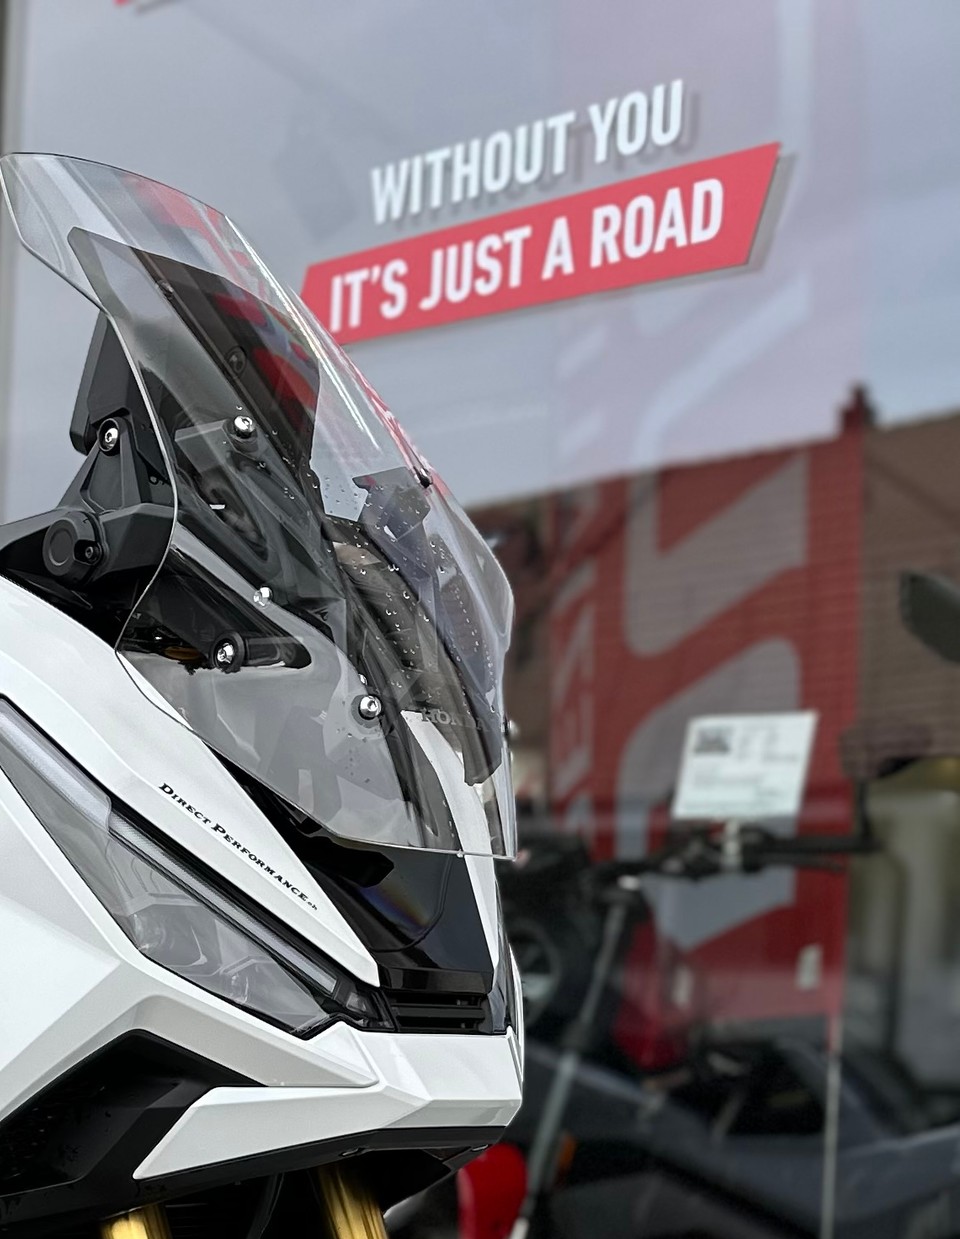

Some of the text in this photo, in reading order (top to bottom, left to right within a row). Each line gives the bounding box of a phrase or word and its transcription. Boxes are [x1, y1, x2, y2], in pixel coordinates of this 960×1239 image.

[371, 79, 684, 224] WITHOUT YOU
[329, 178, 725, 332] IT'S JUST A ROAD
[158, 783, 212, 826] DIRECT
